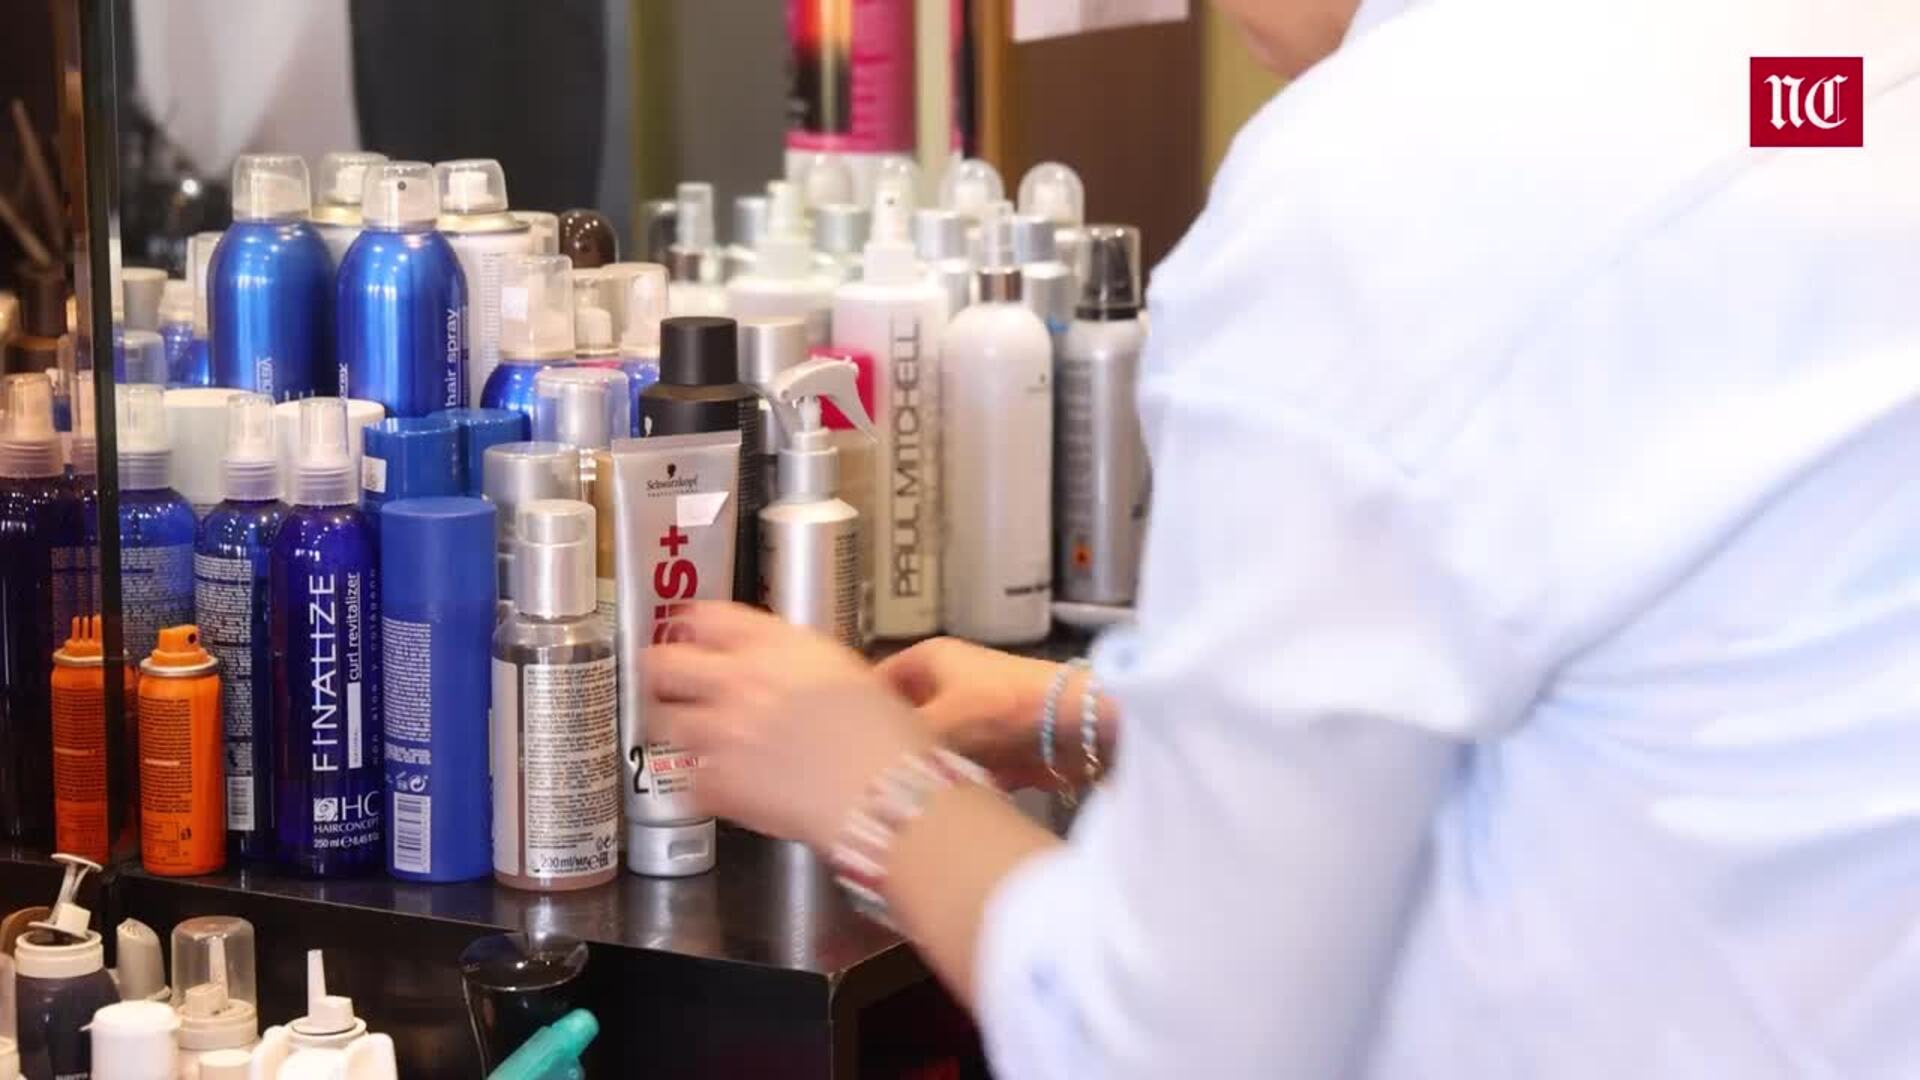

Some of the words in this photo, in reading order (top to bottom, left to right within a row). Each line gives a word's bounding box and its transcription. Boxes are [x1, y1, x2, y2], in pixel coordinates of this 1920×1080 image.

[446, 308, 460, 364] spray
[444, 369, 457, 408] hair
[894, 322, 919, 498] MITCHELL
[894, 505, 919, 598] PAUL
[345, 572, 359, 648] revitalizer
[309, 573, 338, 771] FINALIZE
[346, 652, 359, 680] curl
[630, 745, 649, 794] 2
[313, 816, 379, 833] HAIRCONCEPT
[342, 790, 380, 821] HC
